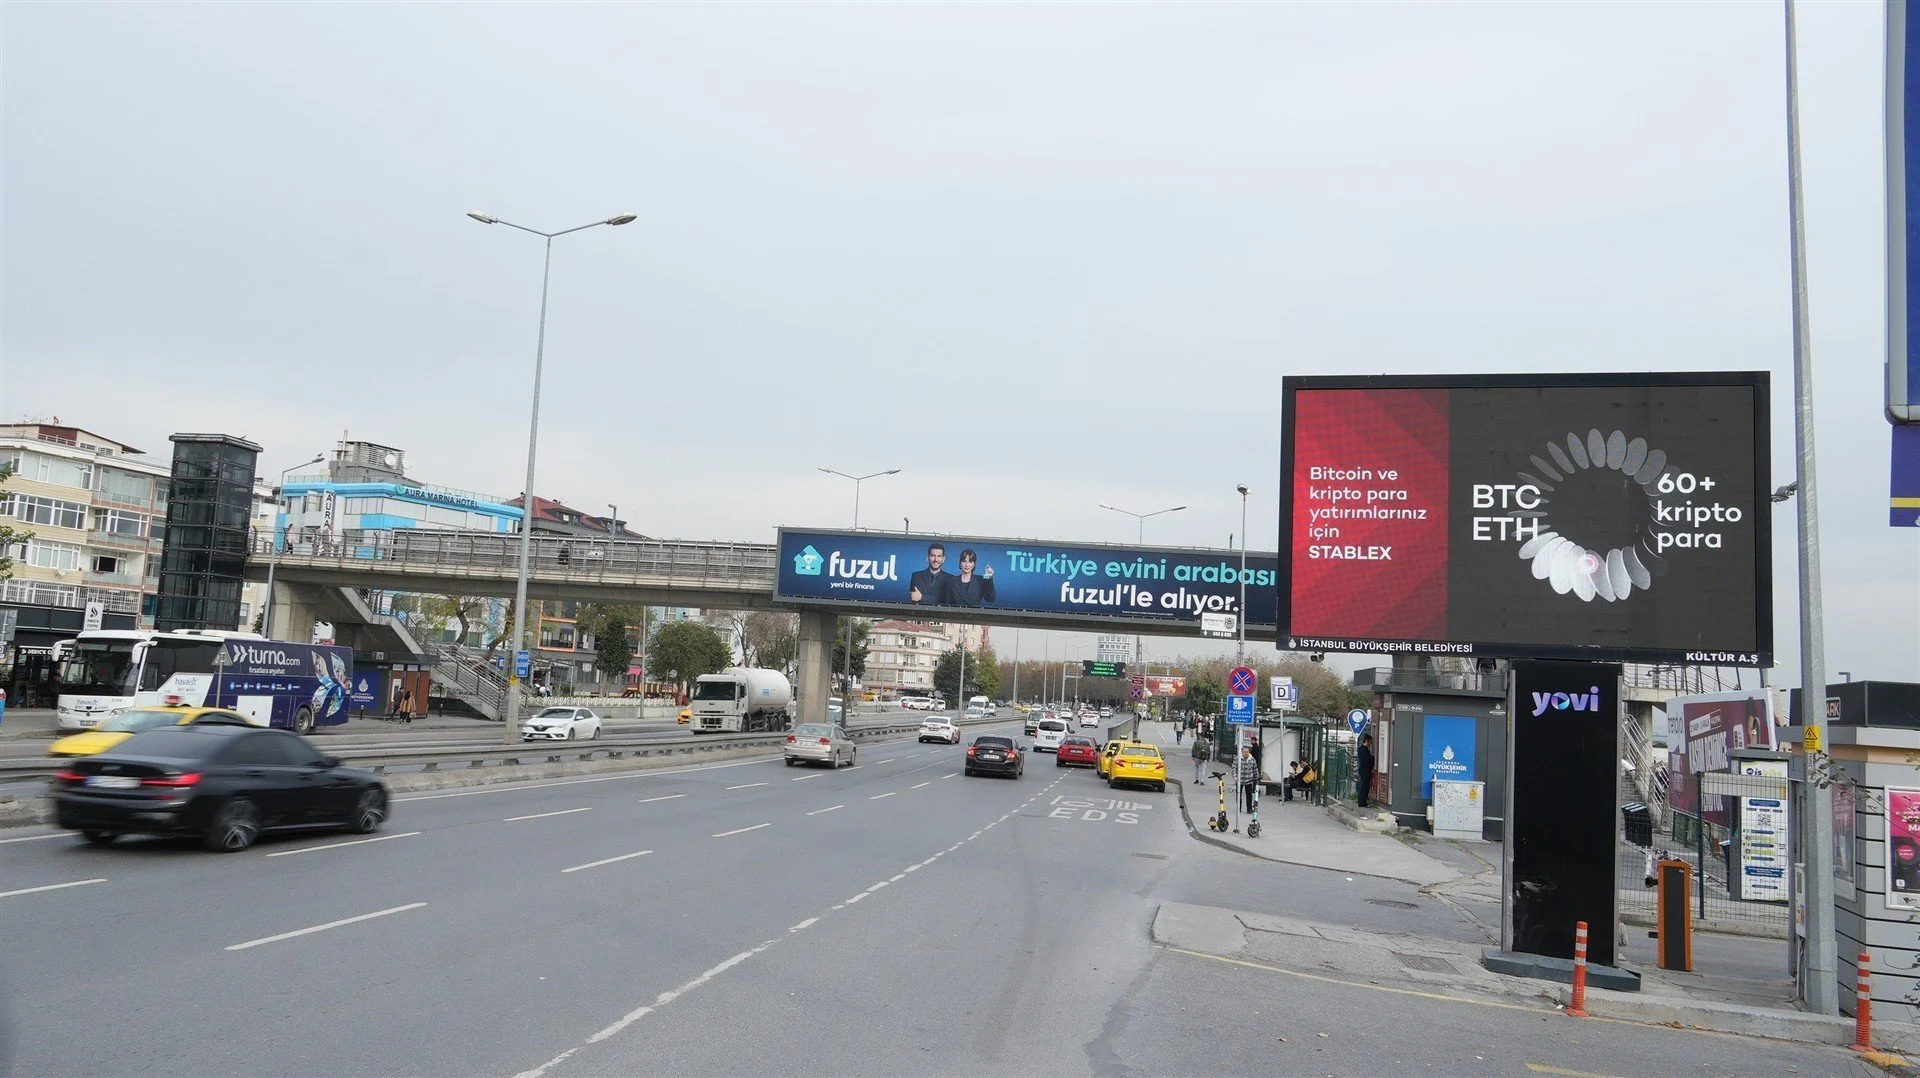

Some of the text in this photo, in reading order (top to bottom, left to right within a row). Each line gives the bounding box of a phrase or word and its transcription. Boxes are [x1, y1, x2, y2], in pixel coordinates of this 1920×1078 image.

[1310, 466, 1398, 480] Bitcoin ve
[1657, 473, 1716, 494] 60+
[404, 488, 478, 508] AURA MARINA HOTEL
[1309, 486, 1407, 504] kripto para
[1472, 484, 1541, 509] BTC
[1309, 505, 1427, 522] yatırımlarınız
[1657, 500, 1742, 527] kripto
[1309, 523, 1340, 541] için
[1472, 516, 1538, 541] ETH
[1657, 530, 1722, 553] para
[1308, 545, 1392, 560] STABLEX
[829, 551, 898, 581] fuzul
[1007, 550, 1276, 586] Türkiye evini arabası
[1160, 587, 1239, 616] alıyor.
[1300, 638, 1473, 653] İSTANBUL BÜYÜKŞEHİR BELEDİYESİ
[248, 646, 300, 666] turna.com
[1686, 651, 1735, 663] KÜLTÜR
[1277, 687, 1286, 698] D
[1532, 686, 1599, 717] yovi
[1429, 763, 1467, 771] BÜYÜKŞEHİR
[1048, 807, 1140, 824] EDS
